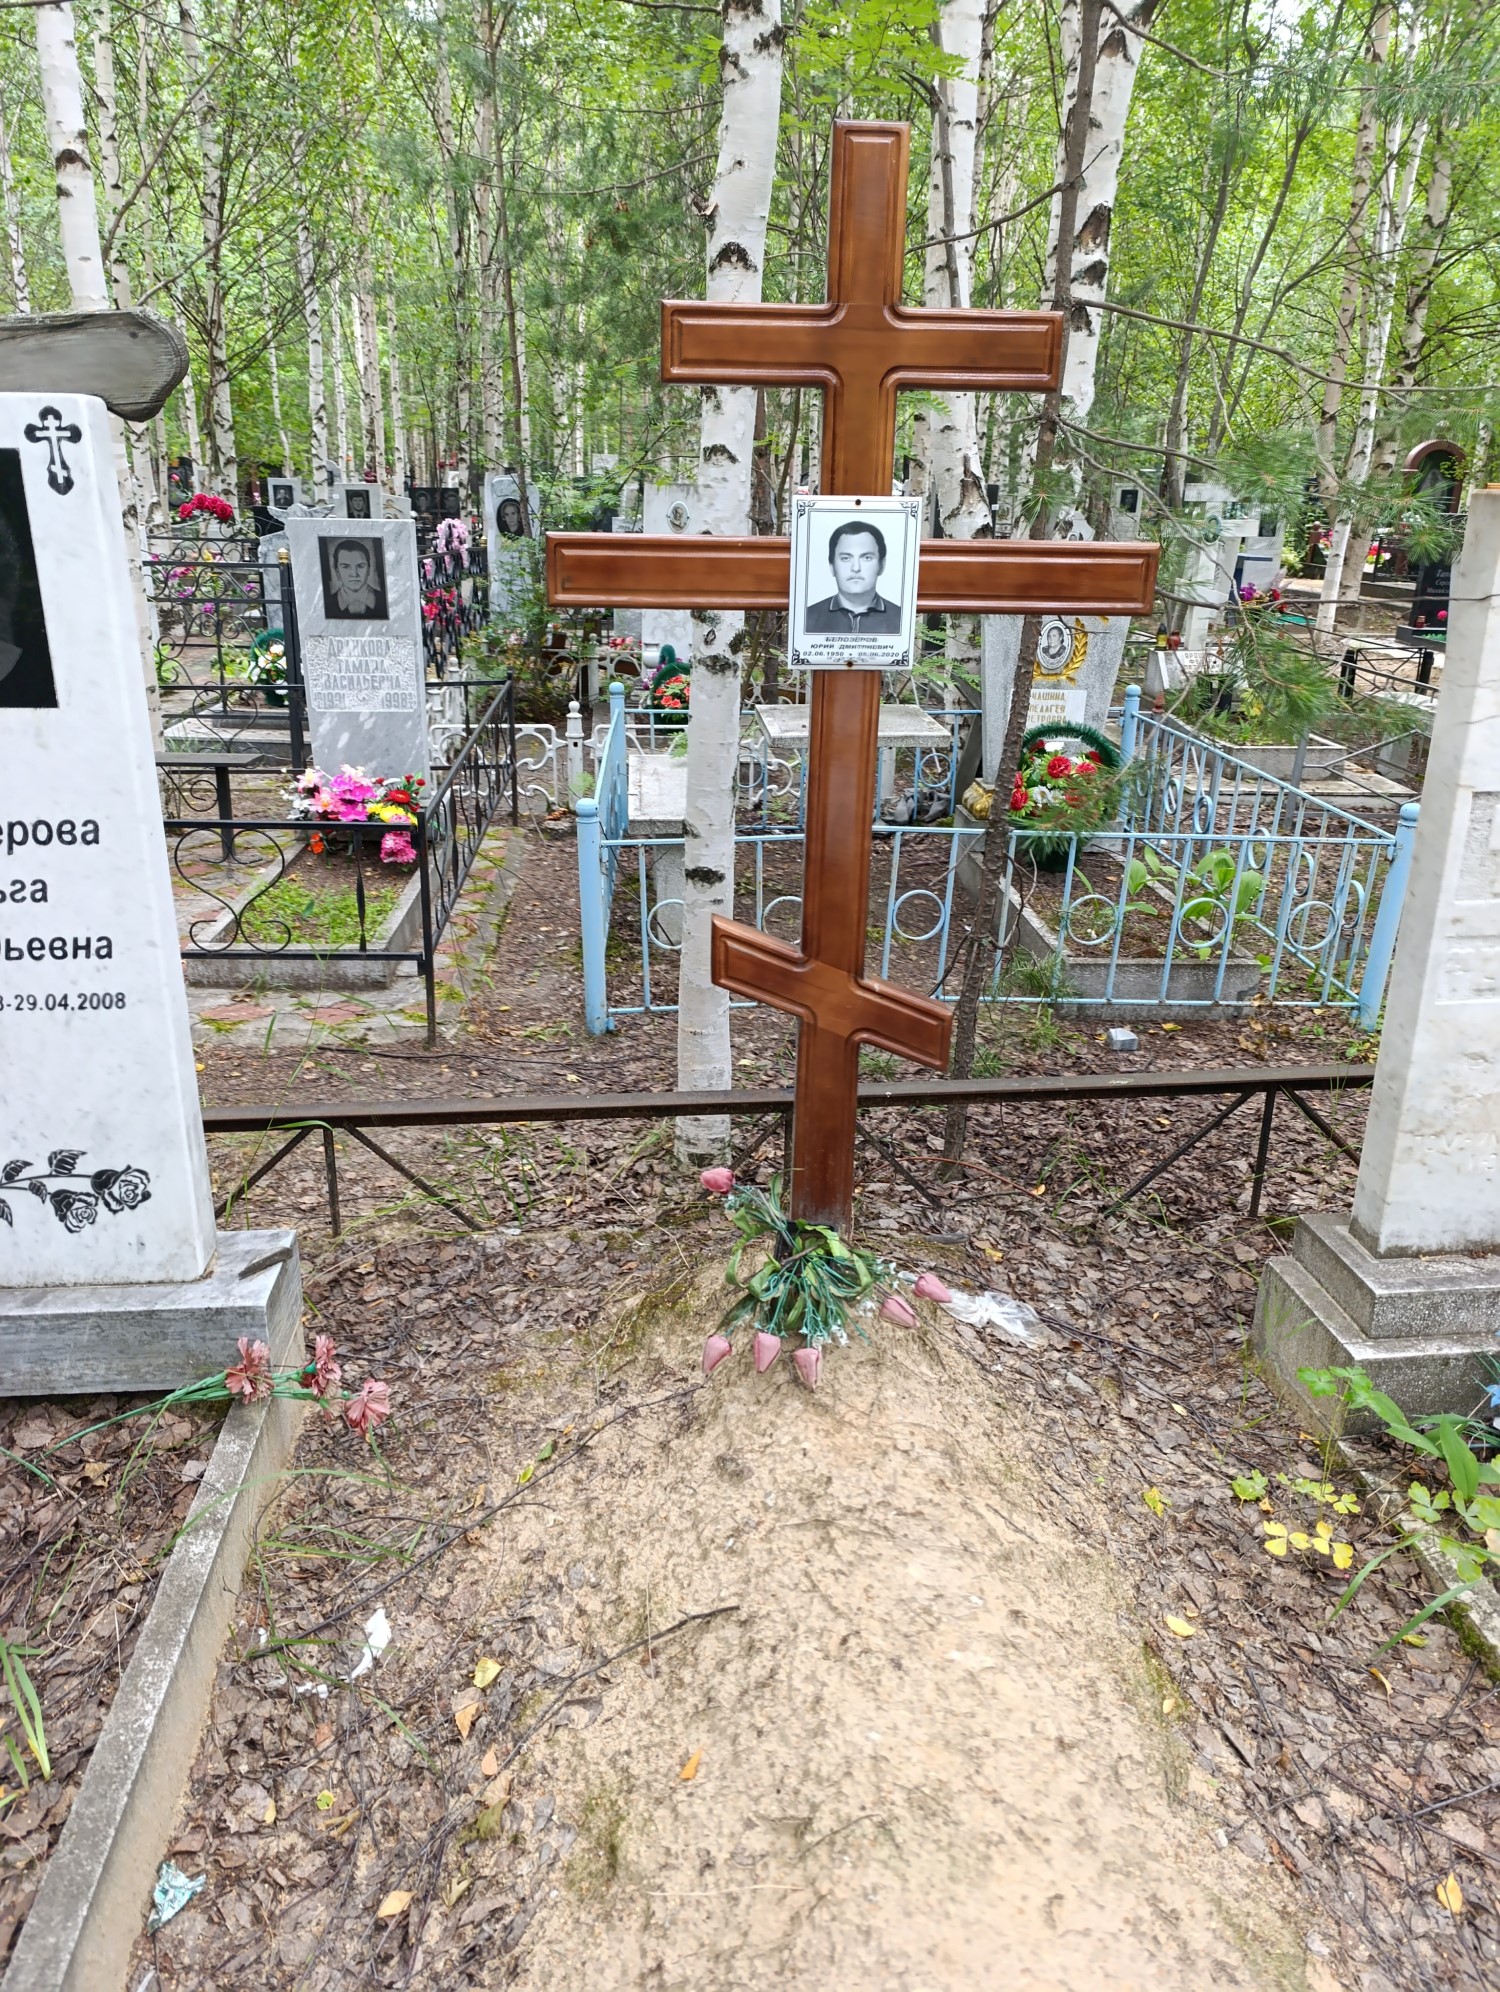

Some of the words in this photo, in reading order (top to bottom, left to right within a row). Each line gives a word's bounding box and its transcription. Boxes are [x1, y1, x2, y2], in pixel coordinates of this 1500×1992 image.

[337, 658, 388, 674] ТАМАРА
[0, 818, 101, 856] рова
[0, 935, 113, 962] ьевна
